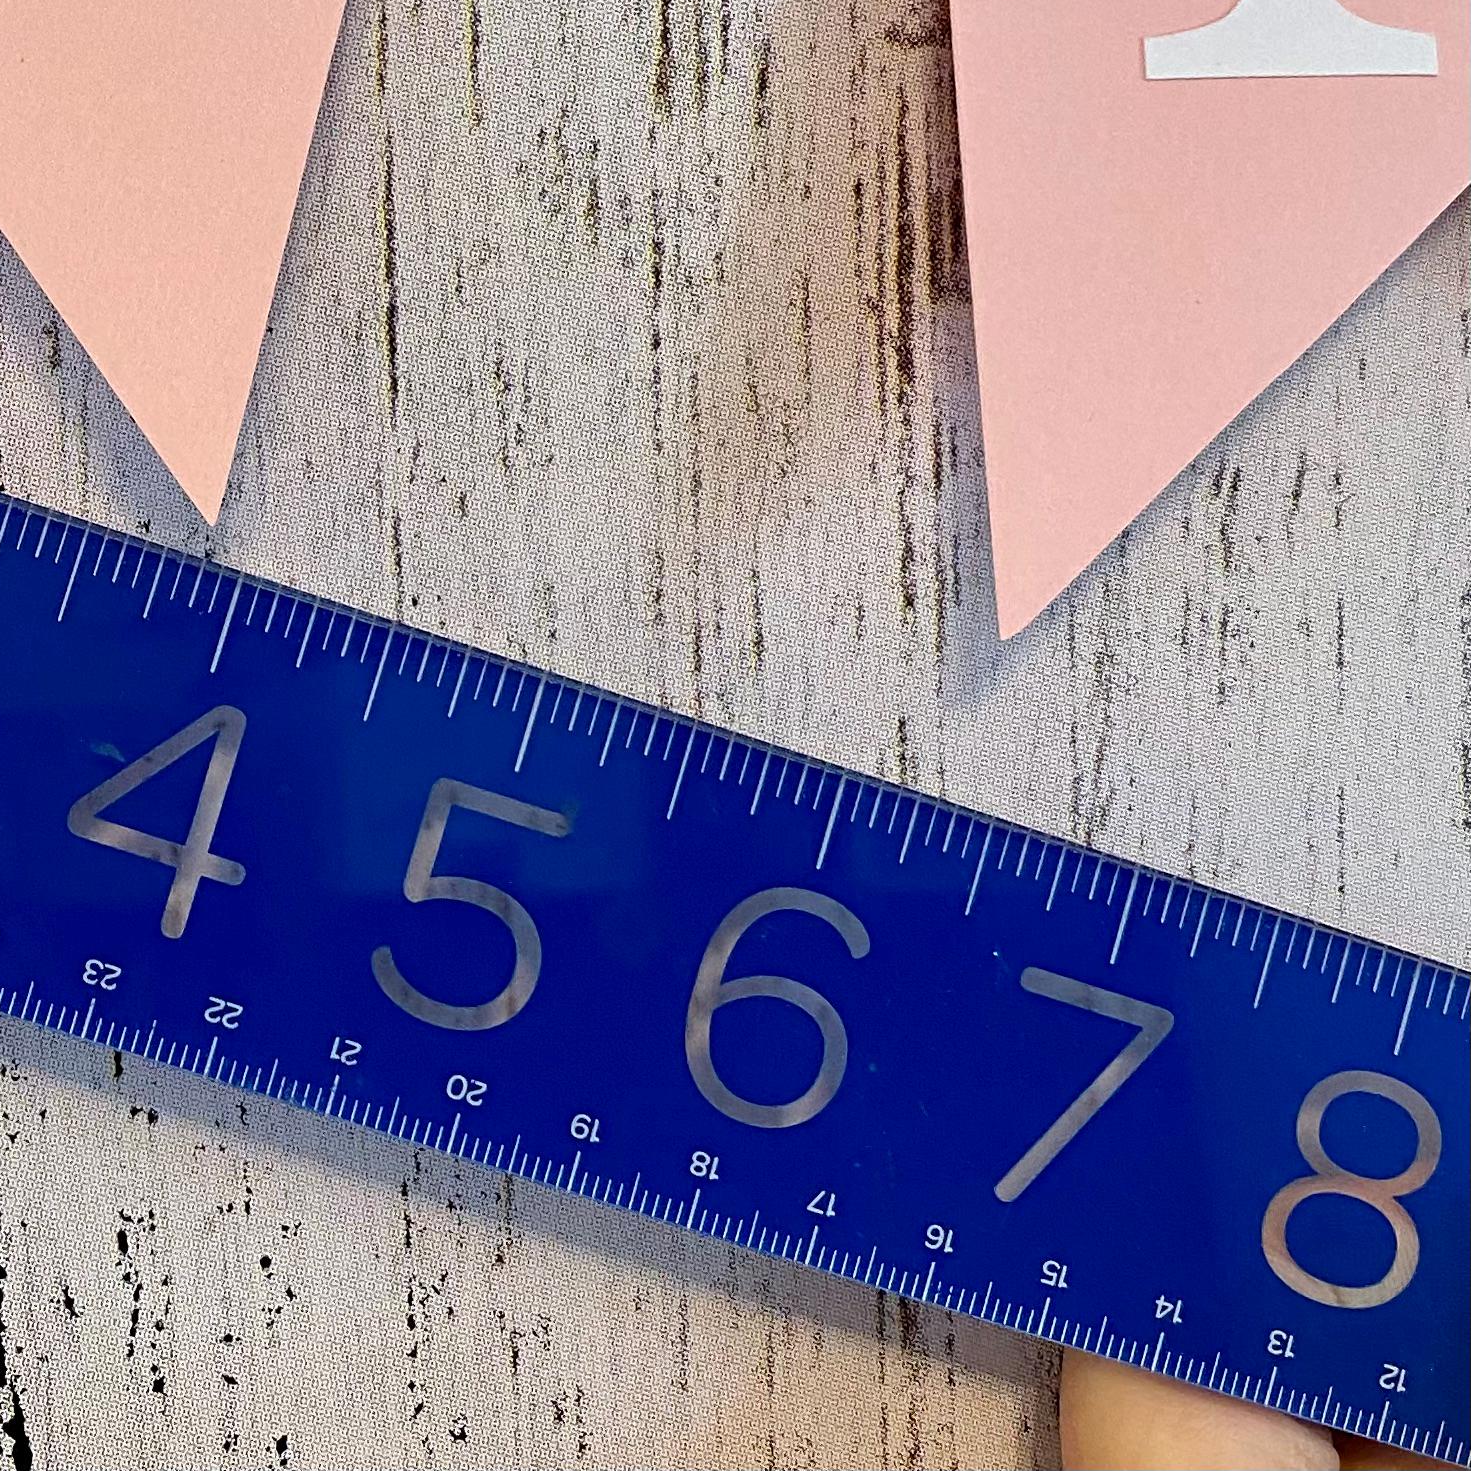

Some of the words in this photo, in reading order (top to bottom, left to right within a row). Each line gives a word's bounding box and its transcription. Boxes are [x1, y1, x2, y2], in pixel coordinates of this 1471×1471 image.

[82, 958, 122, 991] 23
[67, 705, 247, 939] 4
[371, 778, 571, 1031] 5
[684, 887, 871, 1129] 6
[994, 967, 1175, 1203] 7
[1261, 1070, 1442, 1309] 8
[203, 996, 244, 1030] 22
[331, 1036, 363, 1066] 21
[446, 1074, 488, 1107] 20
[570, 1114, 601, 1142] 19
[689, 1150, 720, 1180] 18
[806, 1190, 837, 1217] 17
[924, 1224, 955, 1254] 16
[1040, 1259, 1070, 1289] 15
[1155, 1294, 1185, 1323] 14
[1267, 1329, 1295, 1358] 13
[1378, 1363, 1407, 1393] 12
